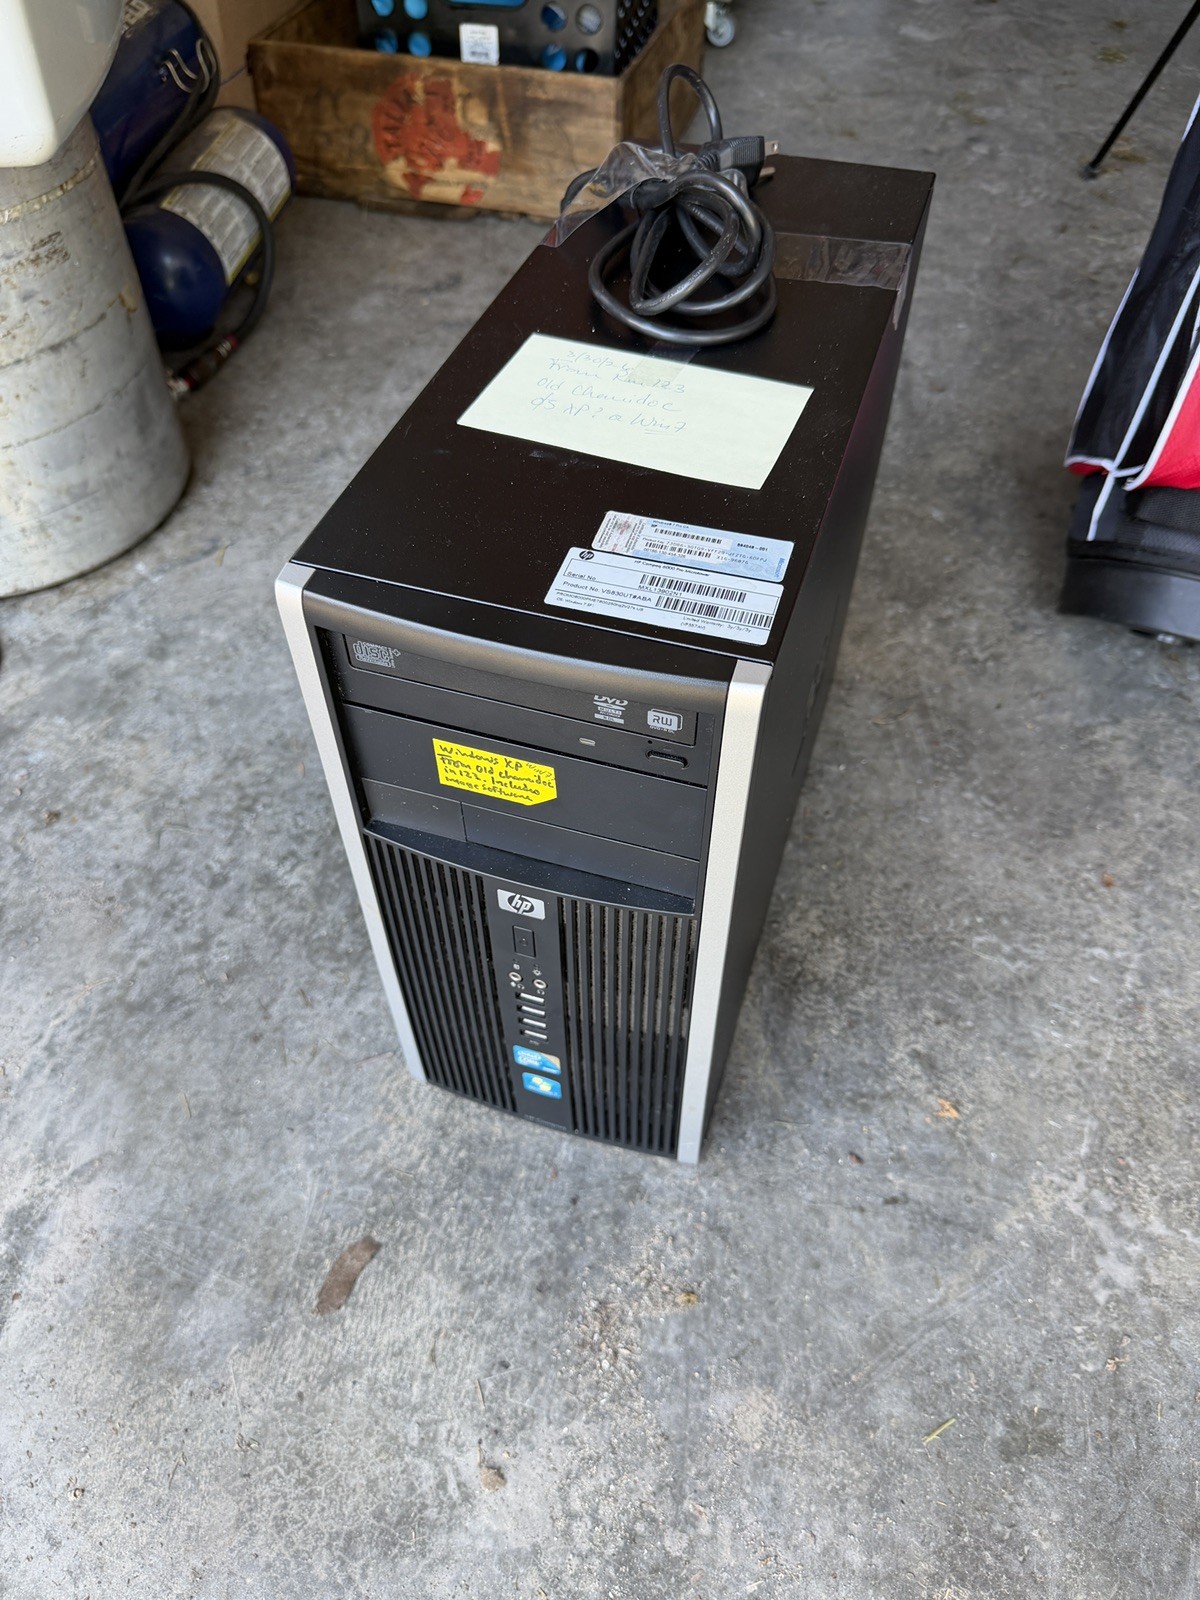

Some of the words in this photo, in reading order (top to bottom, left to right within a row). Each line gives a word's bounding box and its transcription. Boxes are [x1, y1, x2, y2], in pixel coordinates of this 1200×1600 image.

[567, 571, 586, 580] Serial
[563, 580, 589, 591] Product
[653, 714, 673, 727] RW
[438, 744, 499, 765] Windows
[504, 758, 523, 772] XP
